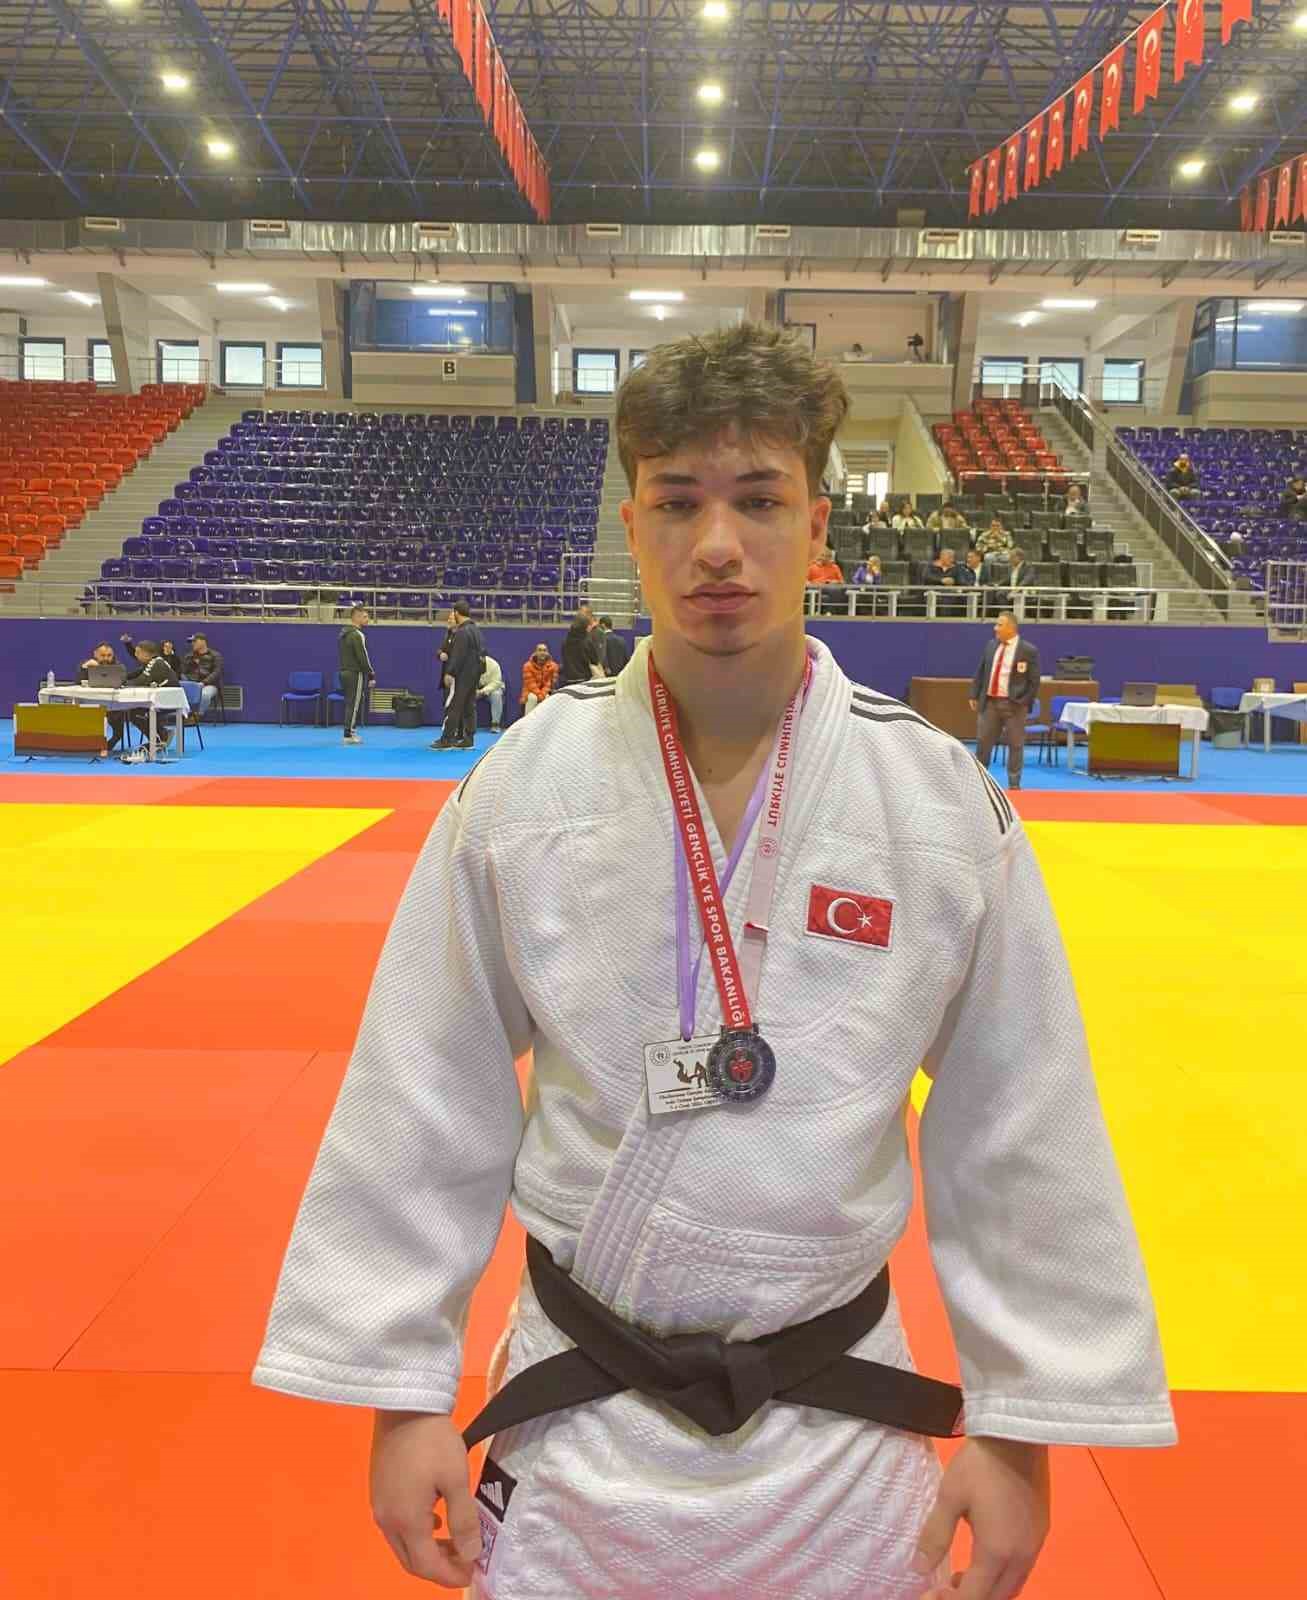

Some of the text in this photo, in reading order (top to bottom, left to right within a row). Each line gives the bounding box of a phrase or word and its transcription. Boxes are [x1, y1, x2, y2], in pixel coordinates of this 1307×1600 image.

[444, 361, 455, 374] B
[664, 734, 696, 819] CUMHURİYETİ
[686, 823, 710, 883] GENÇLİK
[701, 885, 714, 902] VE
[705, 906, 723, 944] SPOR
[716, 946, 745, 1028] BAKANLIĞI
